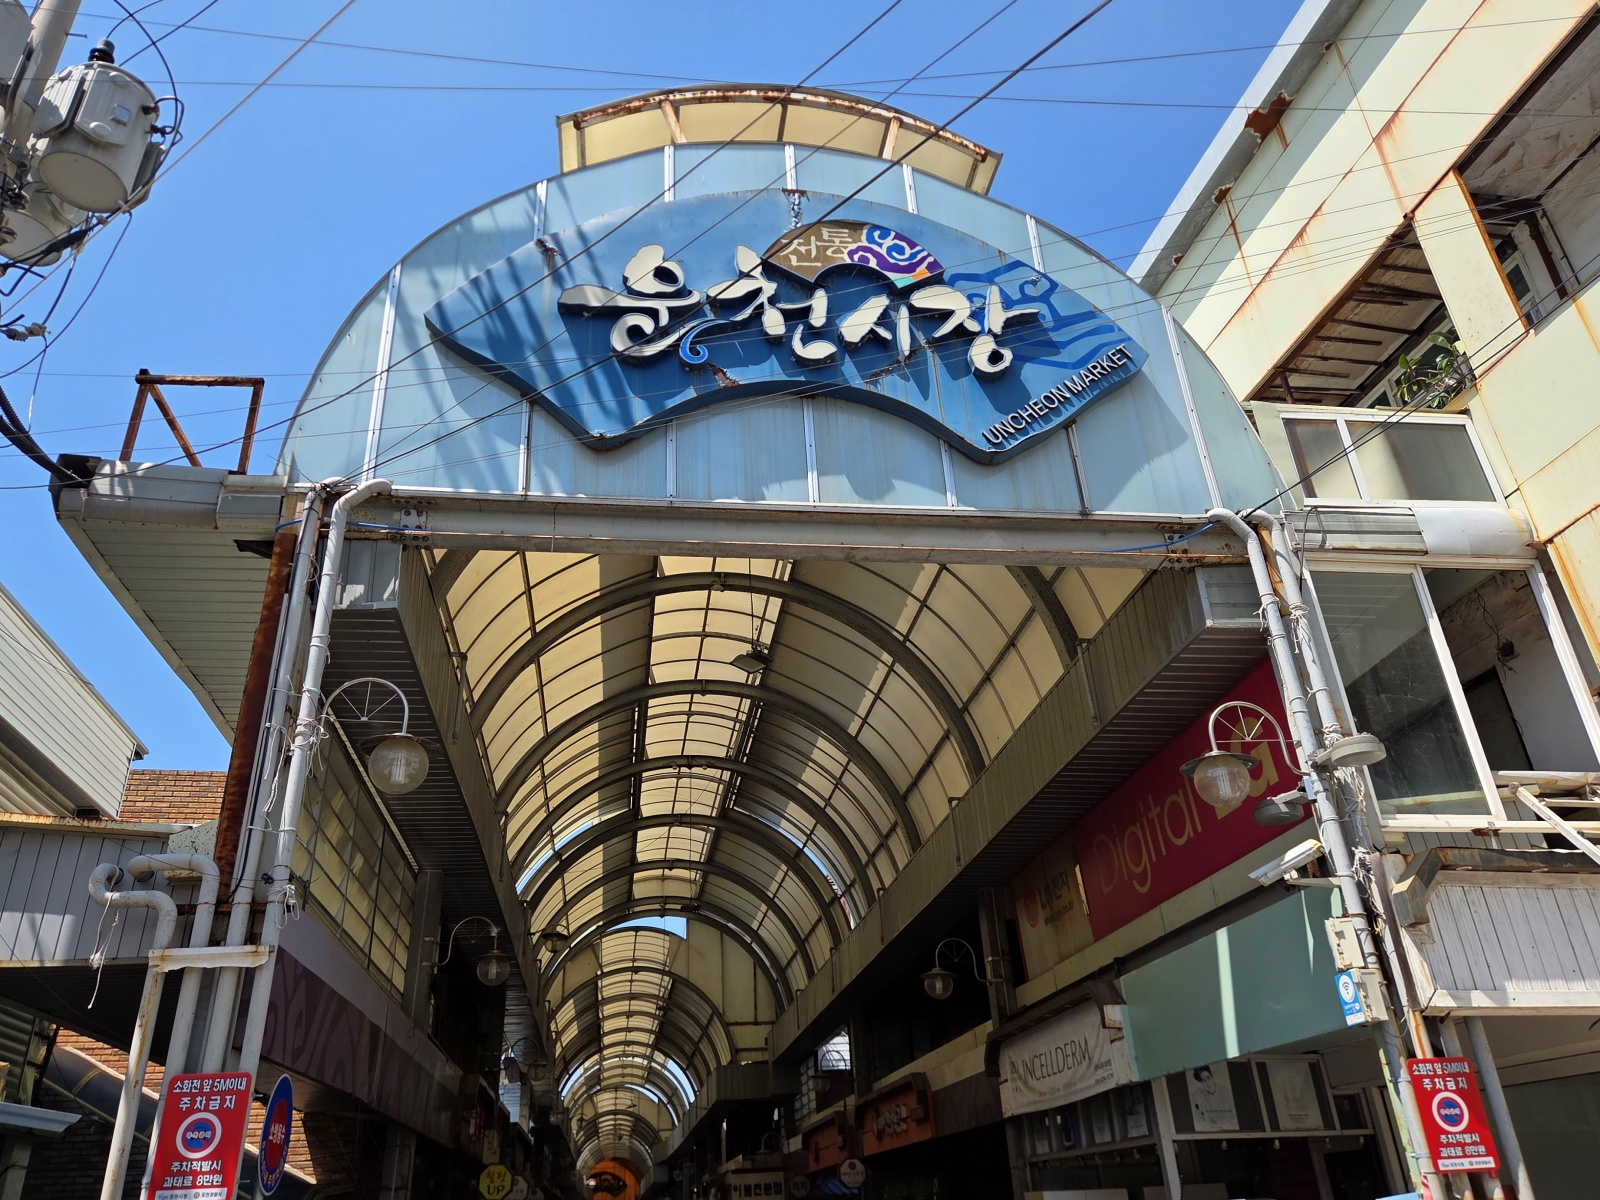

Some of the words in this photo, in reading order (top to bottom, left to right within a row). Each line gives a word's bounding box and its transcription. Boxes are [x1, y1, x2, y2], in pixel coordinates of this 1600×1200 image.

[779, 226, 855, 267] 전통
[557, 243, 1040, 373] 운천시장
[981, 384, 1071, 445] UNCHEON
[1066, 342, 1134, 395] MARKET
[1093, 776, 1203, 895] Digital
[1021, 1034, 1093, 1084] INCELLDERM
[1412, 1063, 1434, 1075] 소화전
[1433, 1063, 1443, 1075] 앞
[1442, 1061, 1470, 1075] 5M이내
[172, 1079, 201, 1094] 소화전
[202, 1078, 212, 1092] 앞
[213, 1077, 247, 1092] 5M이내
[1422, 1076, 1468, 1091] 주차금지
[178, 1094, 236, 1111] 주차금지
[268, 1122, 286, 1145] 소방용수
[170, 1159, 222, 1173] 주차적발시
[162, 1175, 193, 1188] 과태료
[196, 1174, 222, 1186] 8만원
[487, 1184, 505, 1196] UP
